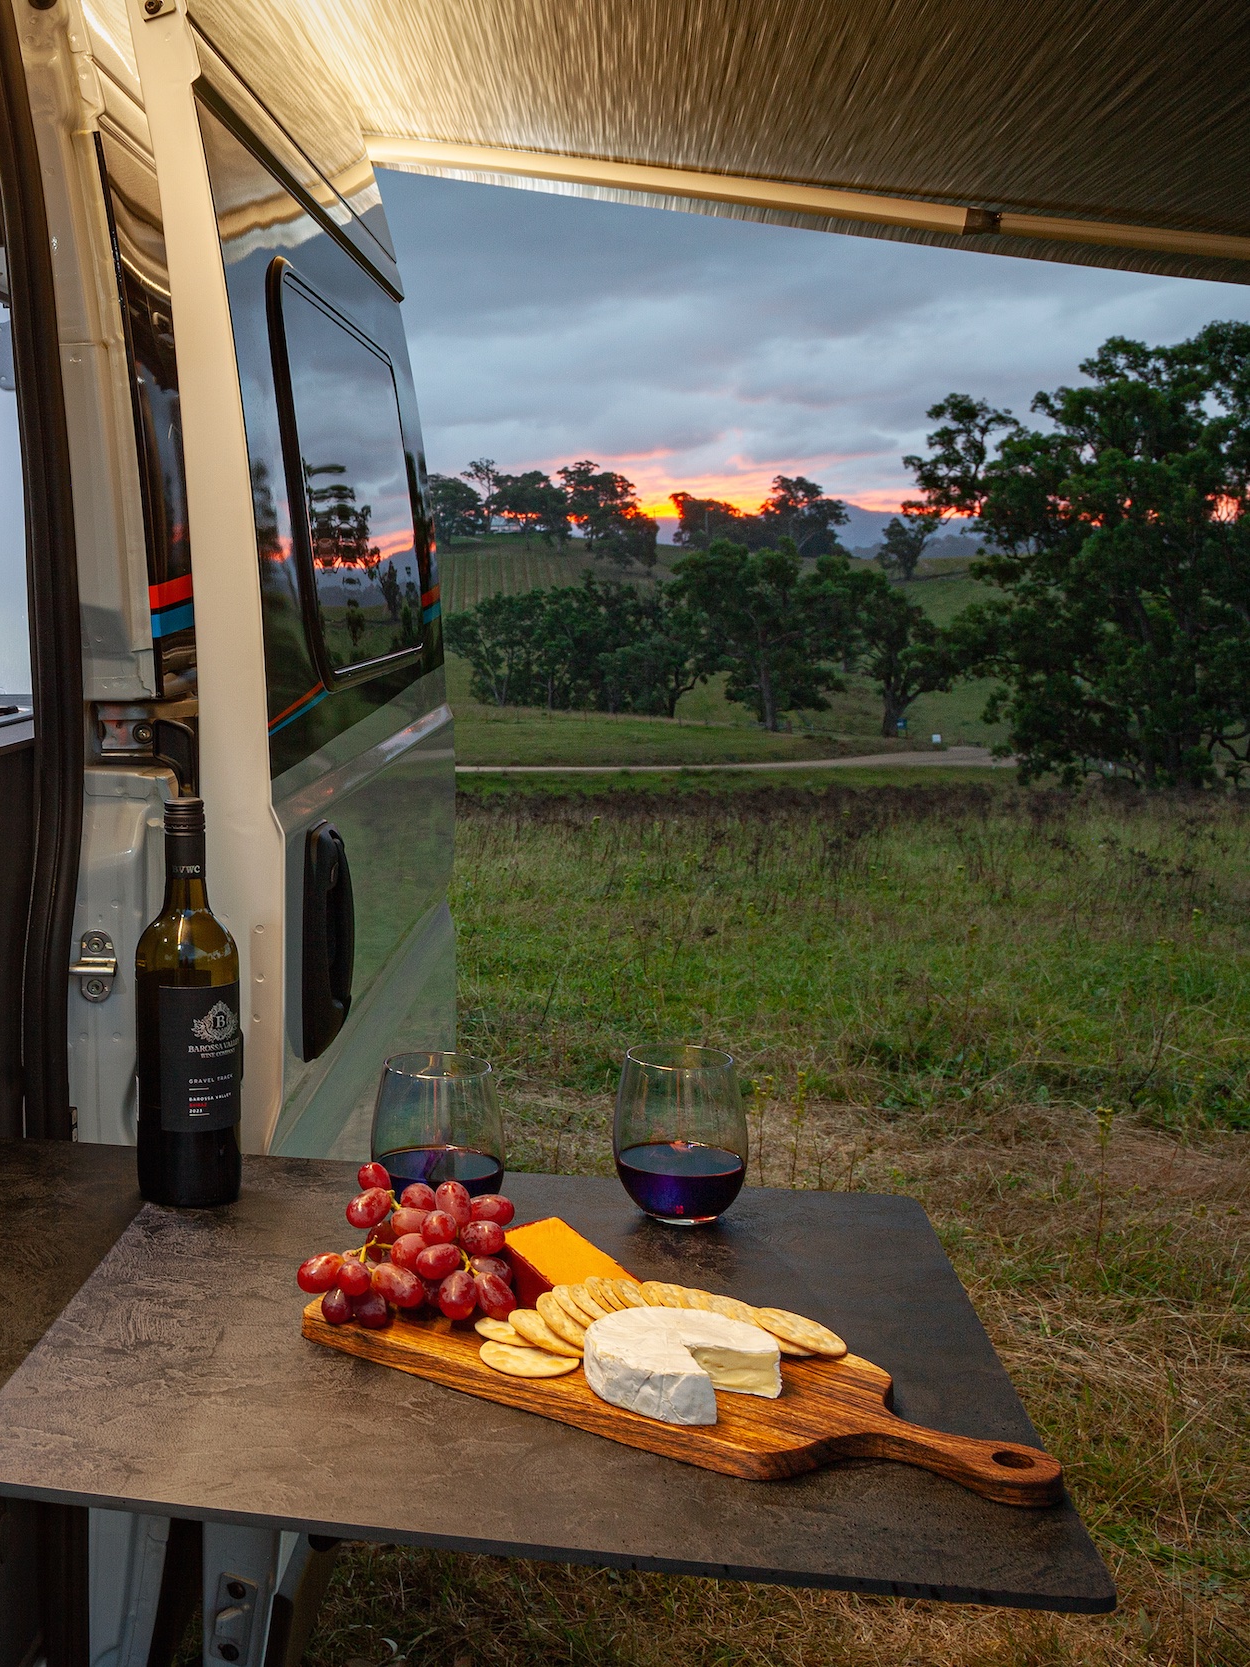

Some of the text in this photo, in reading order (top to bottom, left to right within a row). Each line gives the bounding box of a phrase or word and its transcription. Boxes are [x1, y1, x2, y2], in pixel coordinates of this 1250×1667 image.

[216, 1015, 225, 1028] B
[188, 1044, 223, 1053] BAROSSA
[216, 1073, 234, 1081] TRACK
